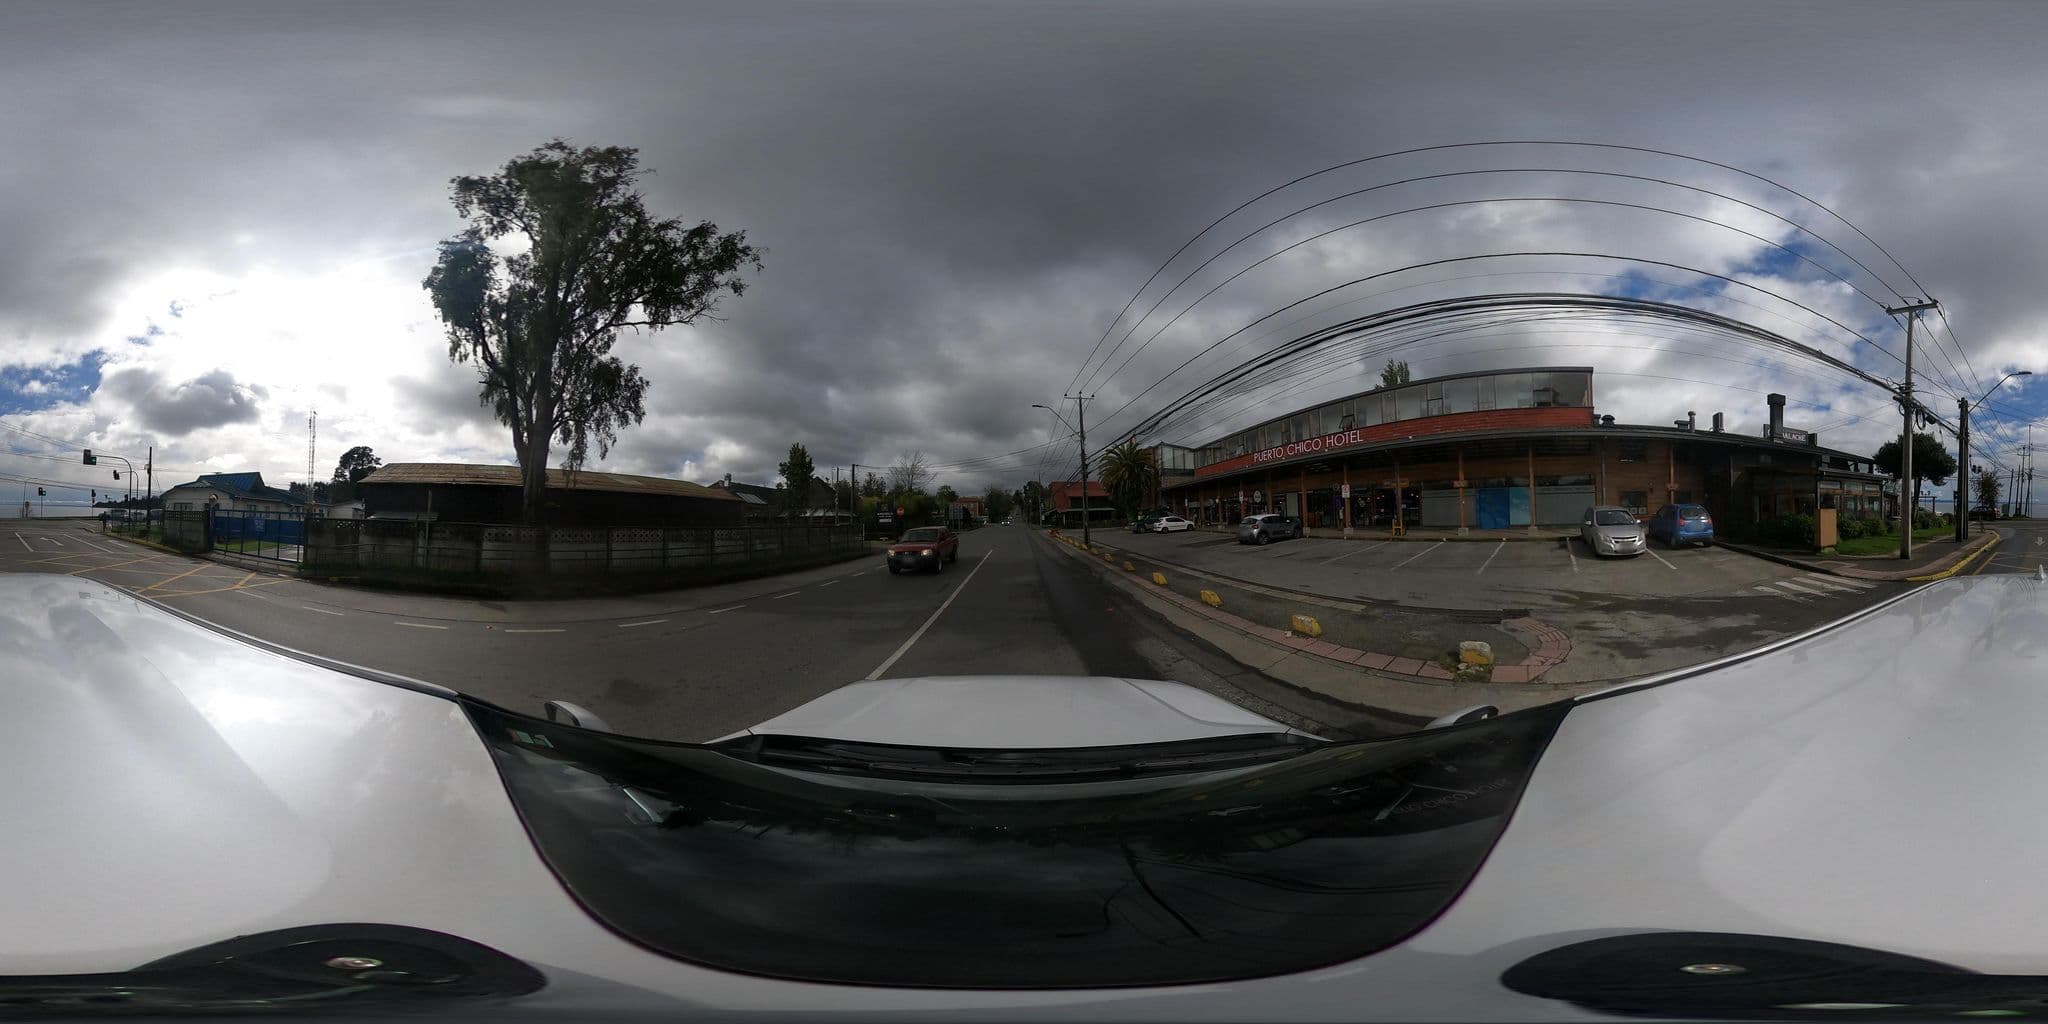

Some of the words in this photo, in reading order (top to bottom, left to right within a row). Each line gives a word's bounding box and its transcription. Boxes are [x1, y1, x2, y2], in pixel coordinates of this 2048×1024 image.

[1254, 447, 1284, 463] PUERTO
[1286, 438, 1321, 456] CHICO
[1326, 430, 1364, 448] HOTEL
